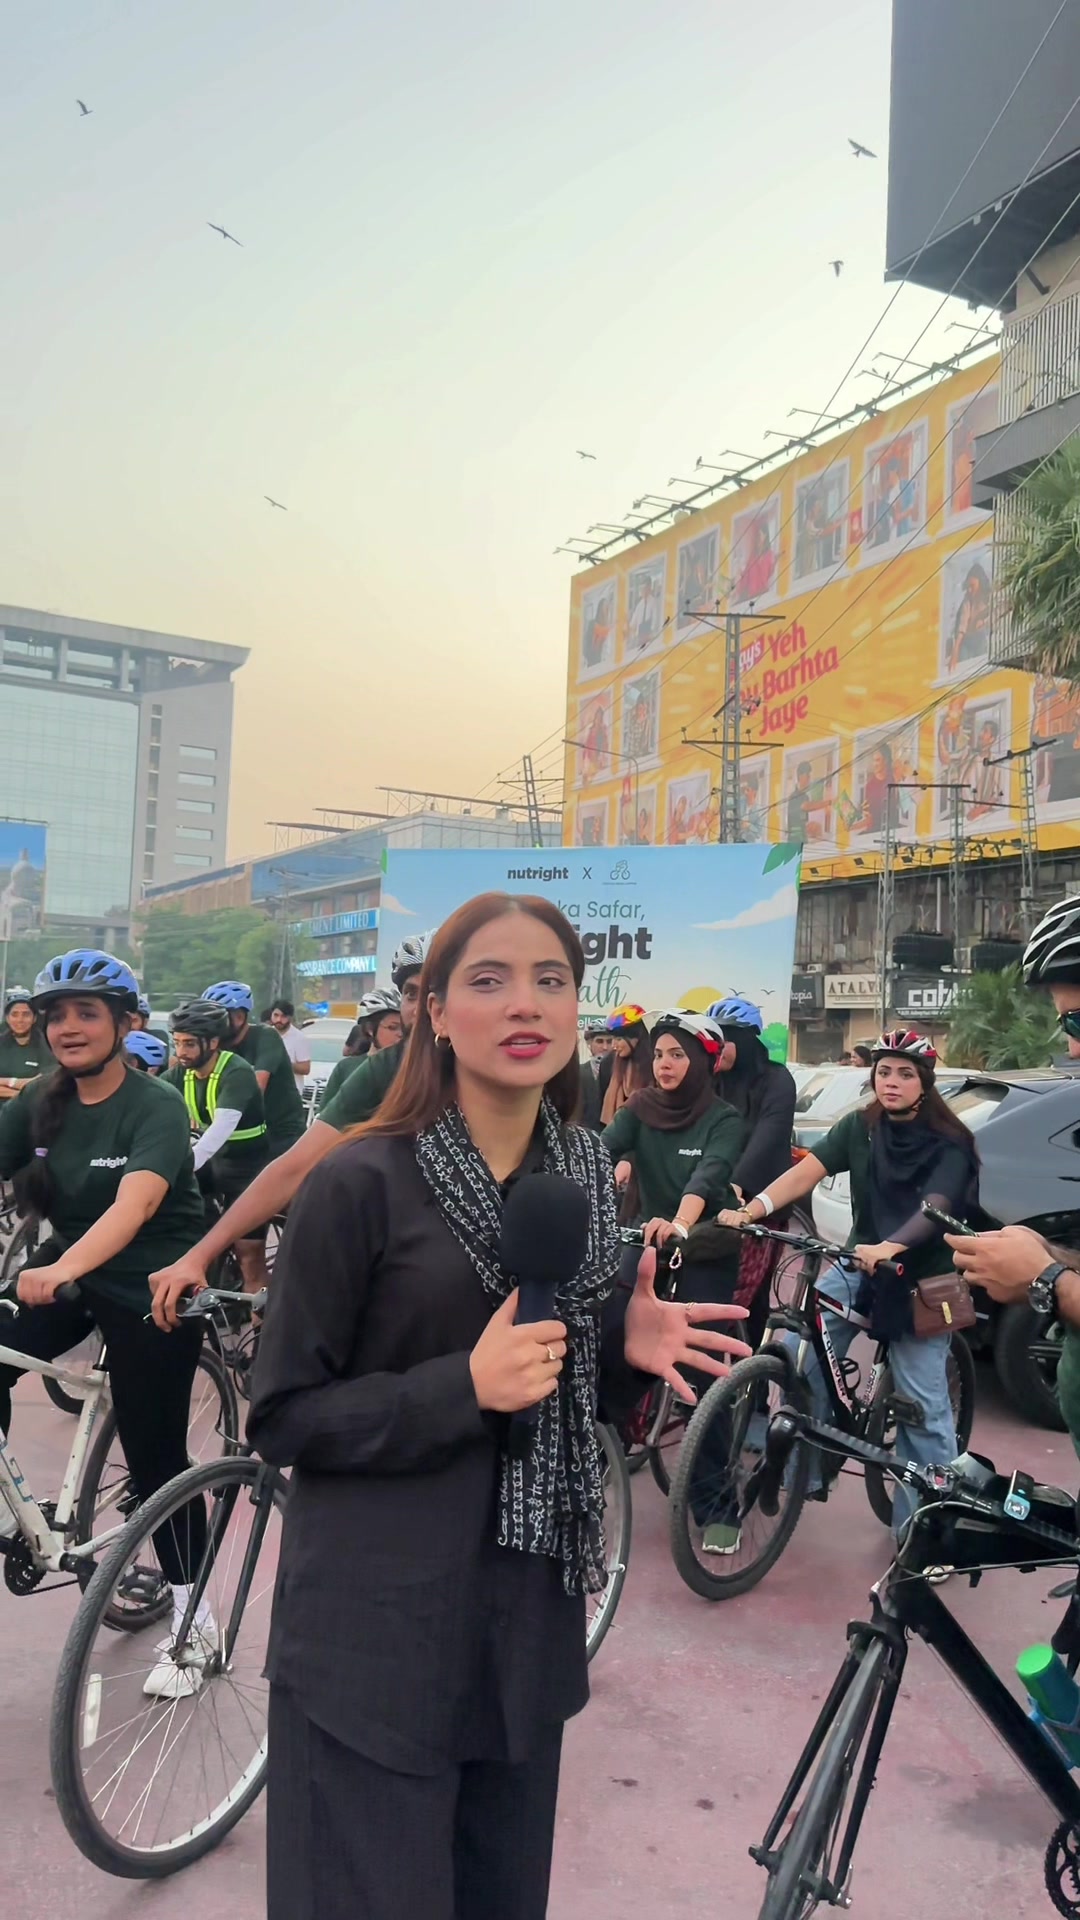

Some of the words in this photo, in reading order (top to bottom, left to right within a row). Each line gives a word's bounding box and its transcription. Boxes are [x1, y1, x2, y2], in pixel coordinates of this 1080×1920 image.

[768, 621, 807, 662] Yeh
[763, 646, 839, 702] Barhta
[759, 695, 809, 737] Jaye
[507, 866, 569, 882] nutright
[335, 911, 369, 931] LIMITED
[587, 900, 646, 921] Safar,
[573, 924, 653, 966] ght
[577, 965, 632, 1008] ath
